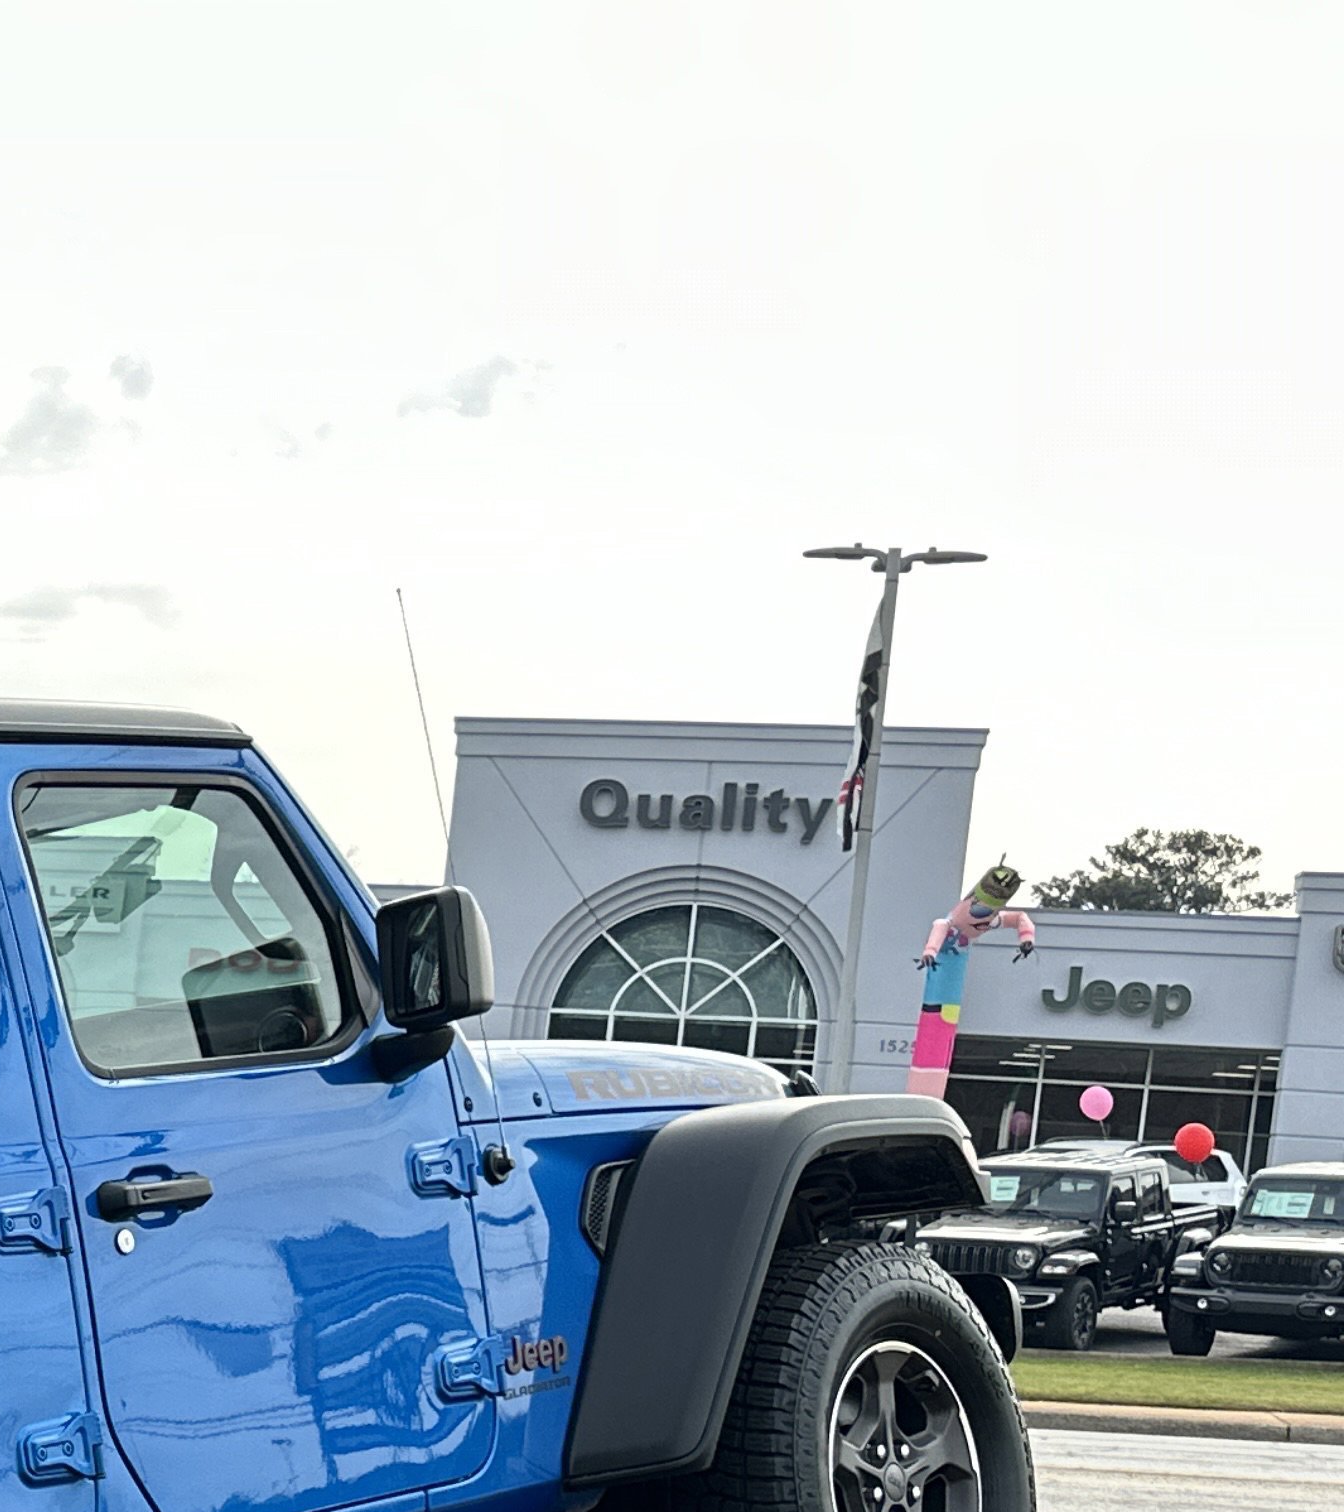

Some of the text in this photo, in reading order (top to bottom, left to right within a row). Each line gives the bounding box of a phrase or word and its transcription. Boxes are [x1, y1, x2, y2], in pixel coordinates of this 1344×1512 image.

[579, 779, 834, 845] Quality
[1041, 966, 1193, 1028] Jeep
[566, 1068, 780, 1101] RUBICON
[505, 1335, 568, 1375] Jeep
